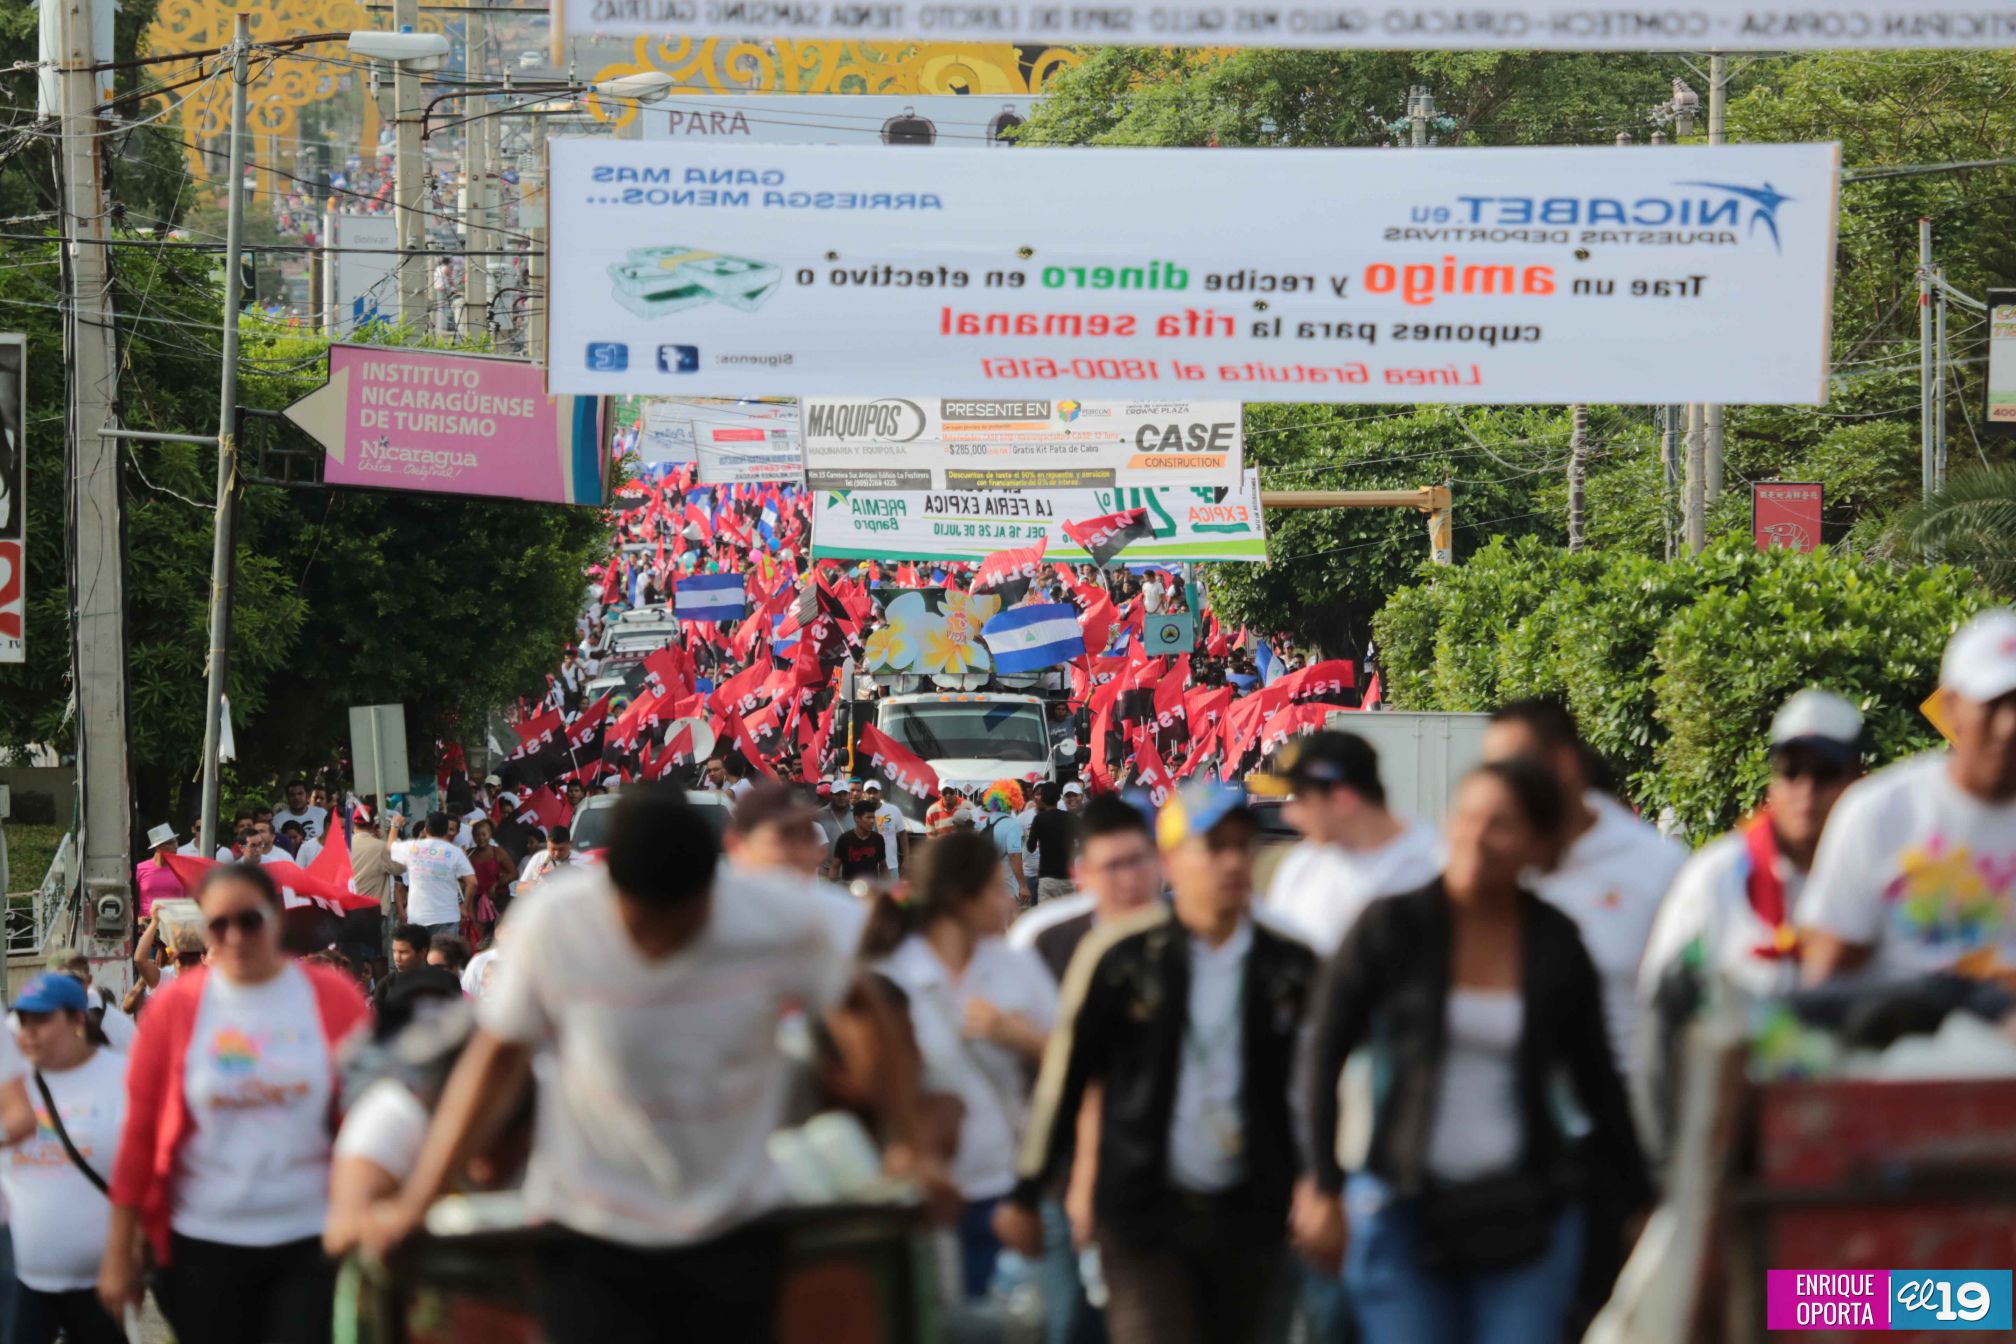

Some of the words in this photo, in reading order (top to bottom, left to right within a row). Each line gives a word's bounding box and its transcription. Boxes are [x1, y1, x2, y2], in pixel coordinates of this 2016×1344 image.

[668, 111, 751, 135] PARA
[362, 362, 480, 388] INSTITUTO
[361, 387, 535, 418] NICARAGÜENSE
[946, 403, 1023, 417] PRESENTE
[1026, 403, 1048, 416] EN
[1161, 406, 1190, 414] PLAZA
[360, 408, 389, 429] DE
[394, 412, 497, 437] TURISMO
[808, 404, 903, 441] MAQUIPOS
[949, 443, 987, 456] $285,000
[1013, 444, 1034, 455] Gratis
[1036, 444, 1048, 454] Kit
[1049, 444, 1067, 454] Pata
[1069, 444, 1078, 453] de
[1080, 443, 1099, 453] Cabra
[1135, 422, 1236, 452] CASE
[360, 439, 478, 468] Nicaragua
[1144, 457, 1221, 468] CONSTRUCTION
[986, 470, 994, 479] de
[870, 752, 931, 801] FSLN
